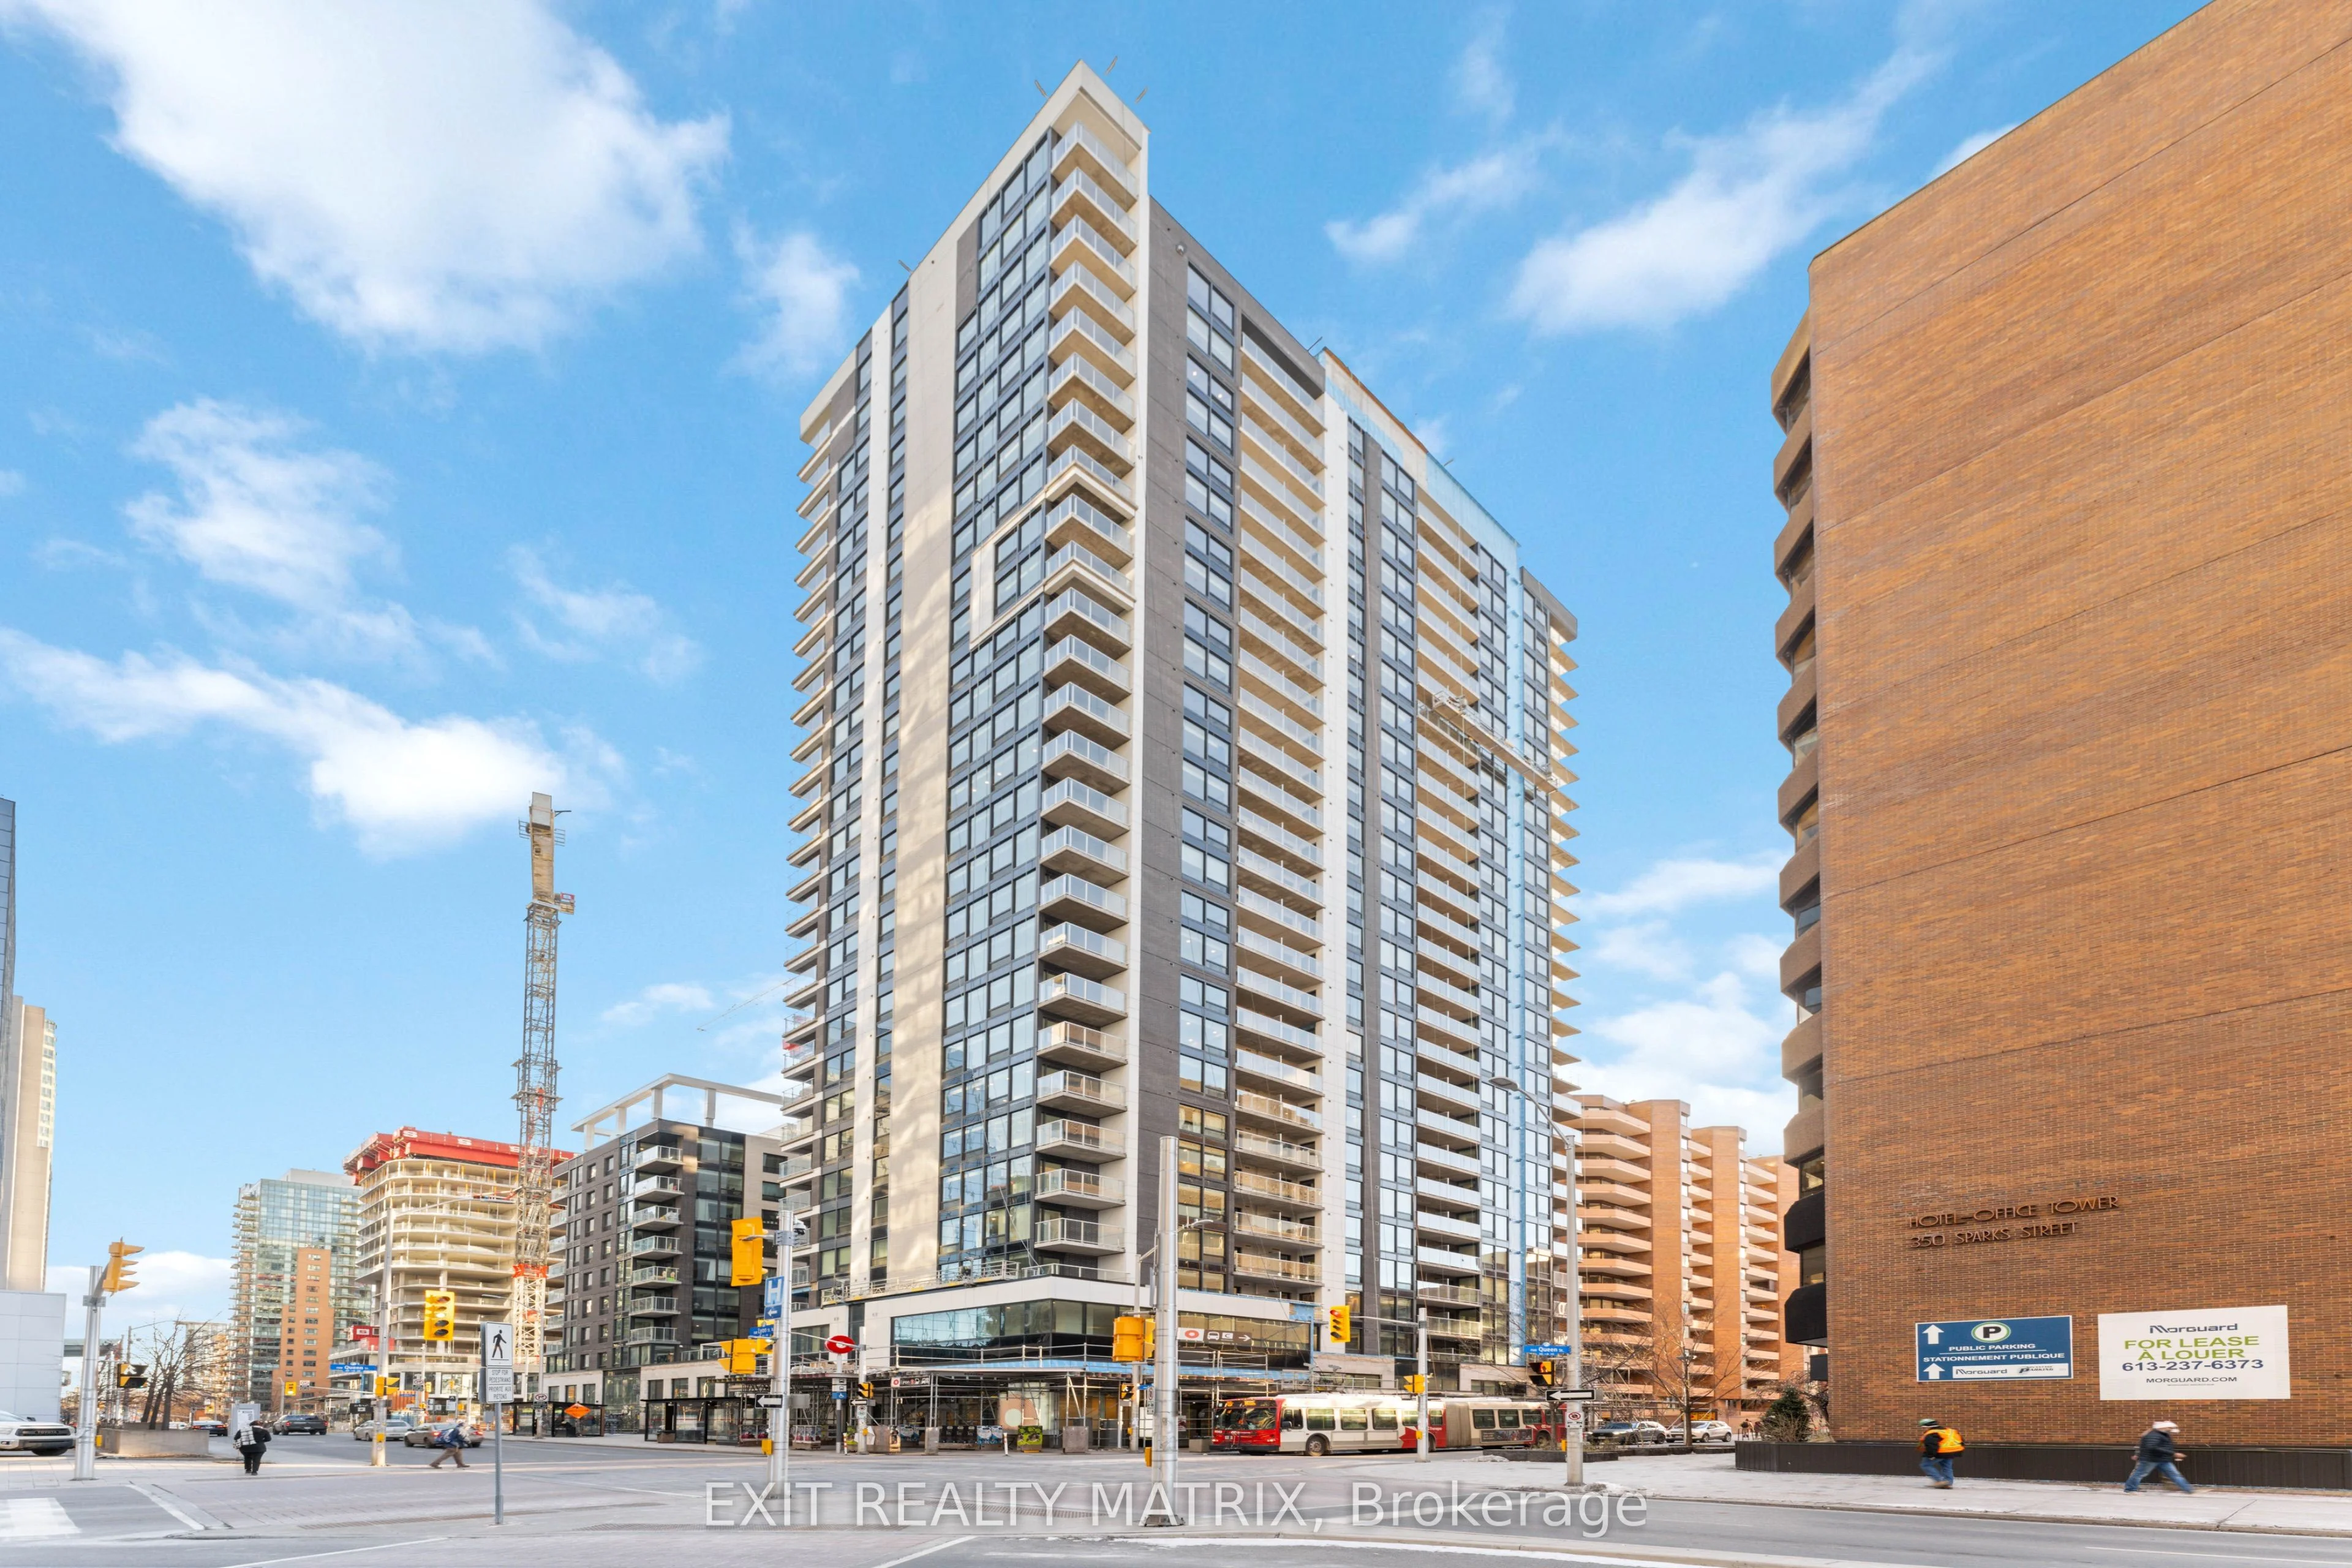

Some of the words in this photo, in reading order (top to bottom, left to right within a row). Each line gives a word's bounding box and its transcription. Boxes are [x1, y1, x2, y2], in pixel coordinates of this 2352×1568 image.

[2049, 1196, 2119, 1215] TOWER
[1910, 1234, 1946, 1248] 350
[1955, 1228, 2011, 1245] SPARKS
[2021, 1222, 2078, 1239] STREET
[767, 1279, 782, 1303] H
[1983, 1326, 2002, 1338] P
[2149, 1324, 2238, 1333] Morguard
[2124, 1340, 2172, 1350] FOR
[2179, 1336, 2260, 1348] LEASE
[2138, 1349, 2154, 1360] À
[2161, 1349, 2245, 1360] LOUER
[2122, 1359, 2264, 1371] 613-237-6373
